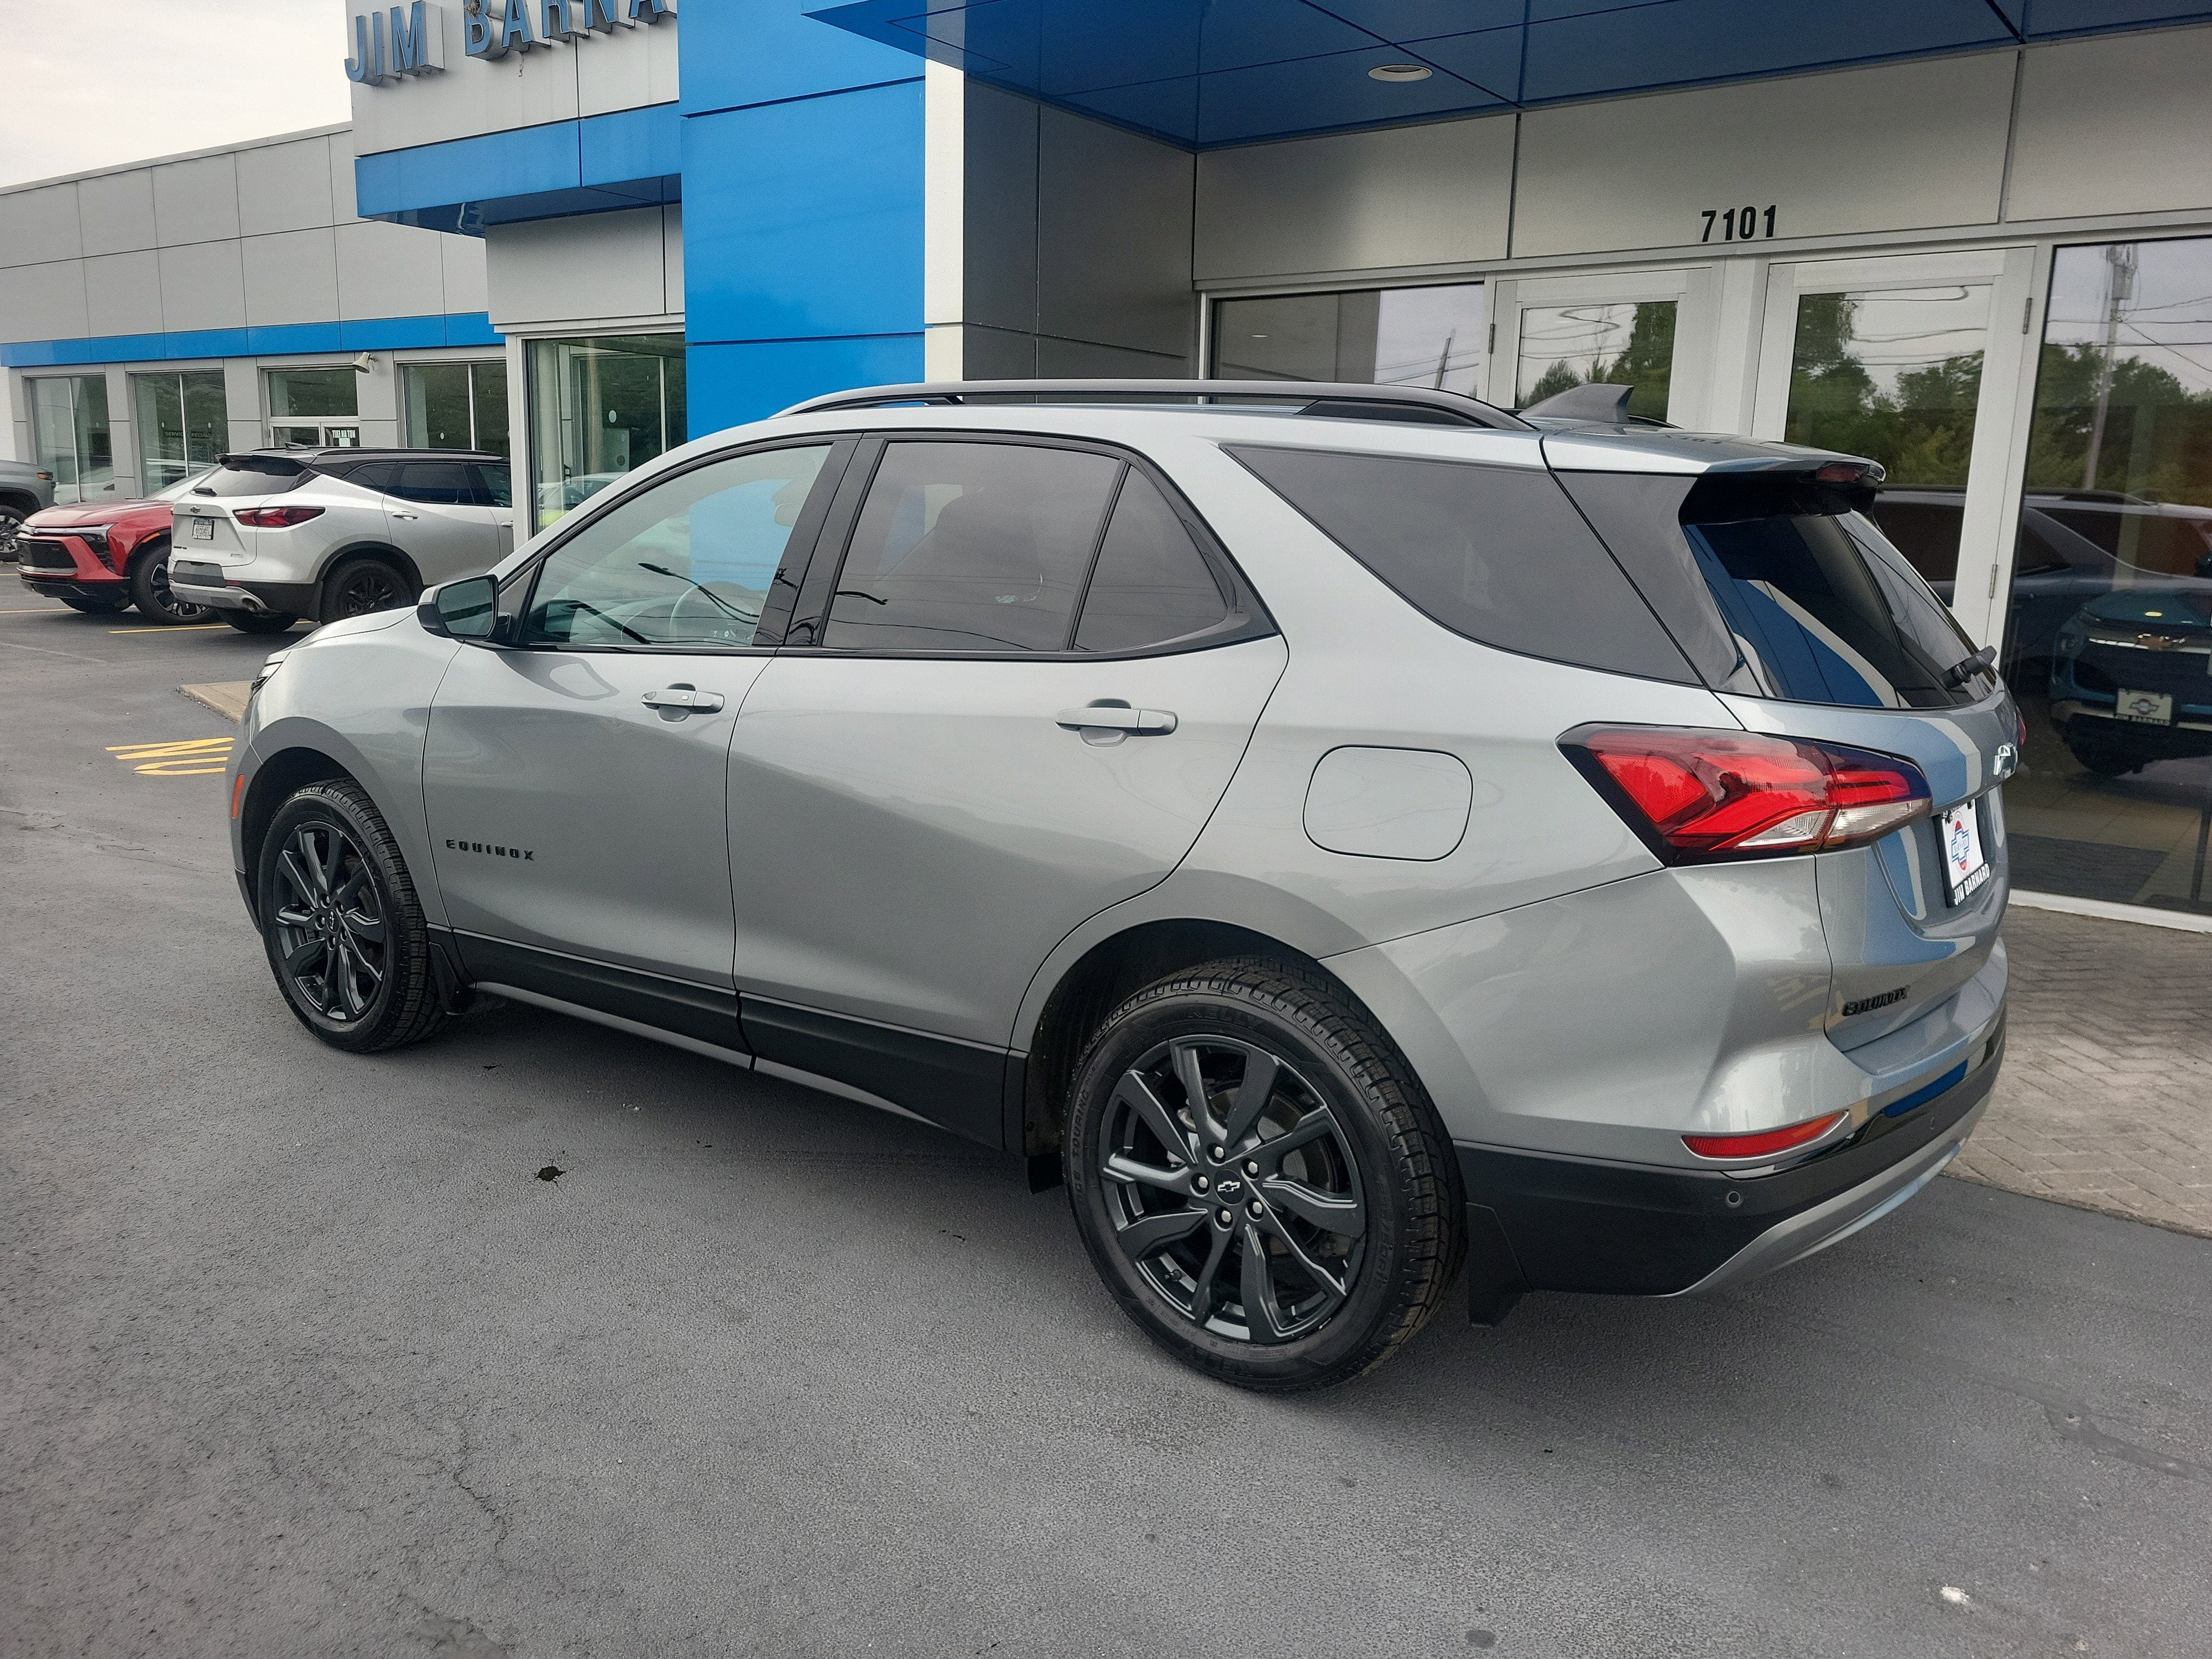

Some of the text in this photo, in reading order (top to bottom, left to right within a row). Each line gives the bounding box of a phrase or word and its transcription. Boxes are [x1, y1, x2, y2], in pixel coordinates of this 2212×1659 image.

[344, 1, 431, 83] JIM
[1701, 205, 1777, 243] 7101
[446, 839, 534, 861] EQUINOX
[1954, 863, 1990, 906] JIM BARNARD
[1072, 1089, 1089, 1158] TOURING
